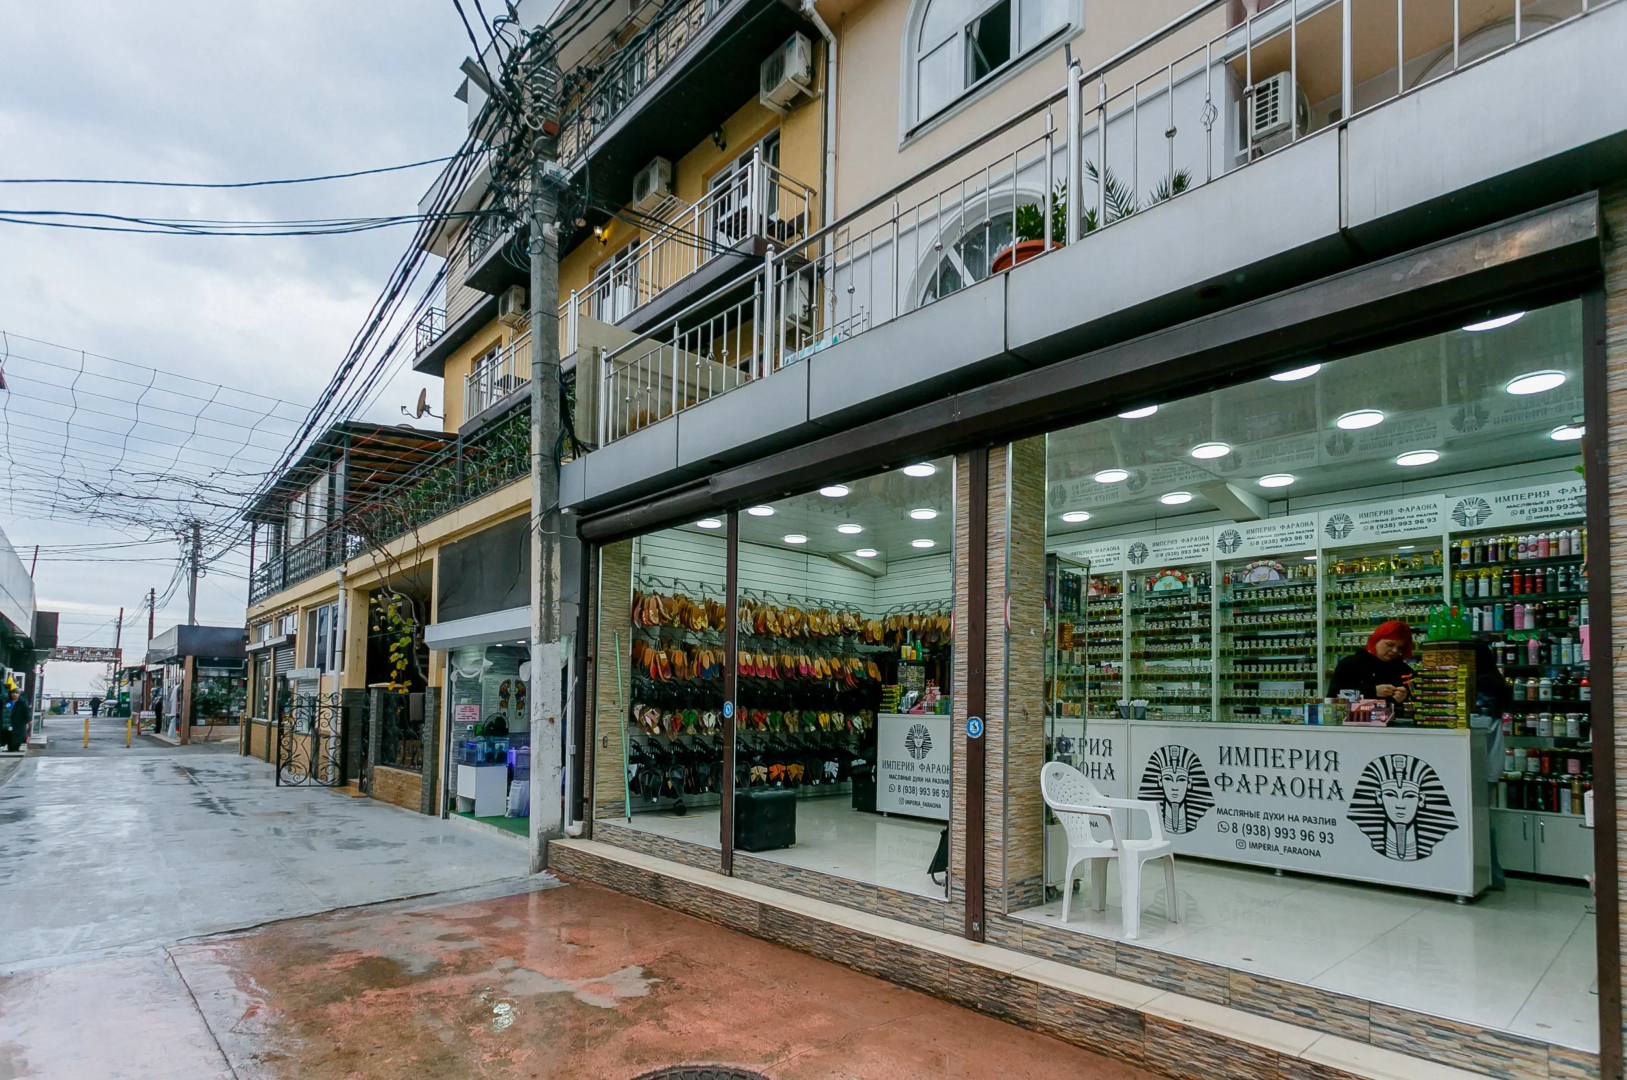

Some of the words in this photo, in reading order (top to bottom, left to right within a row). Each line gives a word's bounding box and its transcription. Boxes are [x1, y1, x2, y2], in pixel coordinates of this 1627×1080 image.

[1494, 490, 1550, 504] ИМПЕРИЯ
[1558, 485, 1586, 495] ФАР
[1358, 508, 1394, 519] ИМПЕРИЯ
[1398, 503, 1438, 514] ФАРАОНА
[1528, 506, 1553, 515] (938)
[1246, 526, 1276, 534] ИМПЕРИЯ
[1280, 520, 1314, 530] ФАРАОНА
[1376, 522, 1396, 530] (938)
[1152, 539, 1178, 547] ИМПЕРИЯ
[1180, 535, 1209, 543] ФАРАОНА
[882, 760, 915, 772] ИМПЕРИЯ
[919, 762, 951, 774] ФАРАОН
[1218, 746, 1340, 773] ИМПЕРИЯ
[1079, 762, 1116, 780] ОНА
[903, 785, 918, 796] (938)
[919, 787, 931, 796] 993
[932, 789, 940, 797] 96
[942, 789, 950, 798] 93
[1214, 772, 1346, 802] ФАРАОНА
[1216, 808, 1261, 819] МАСЛЯНЫЕ
[1263, 812, 1284, 822] ДУХИ
[1288, 815, 1300, 823] НА
[1302, 816, 1337, 826] РАЗЛИВ
[1232, 822, 1238, 833] 8
[1242, 823, 1271, 840] (938)
[1274, 827, 1296, 840] 993
[1300, 830, 1315, 842] 96
[1319, 832, 1335, 844] 93
[1249, 842, 1321, 858] IMPERIA_FARAONA
